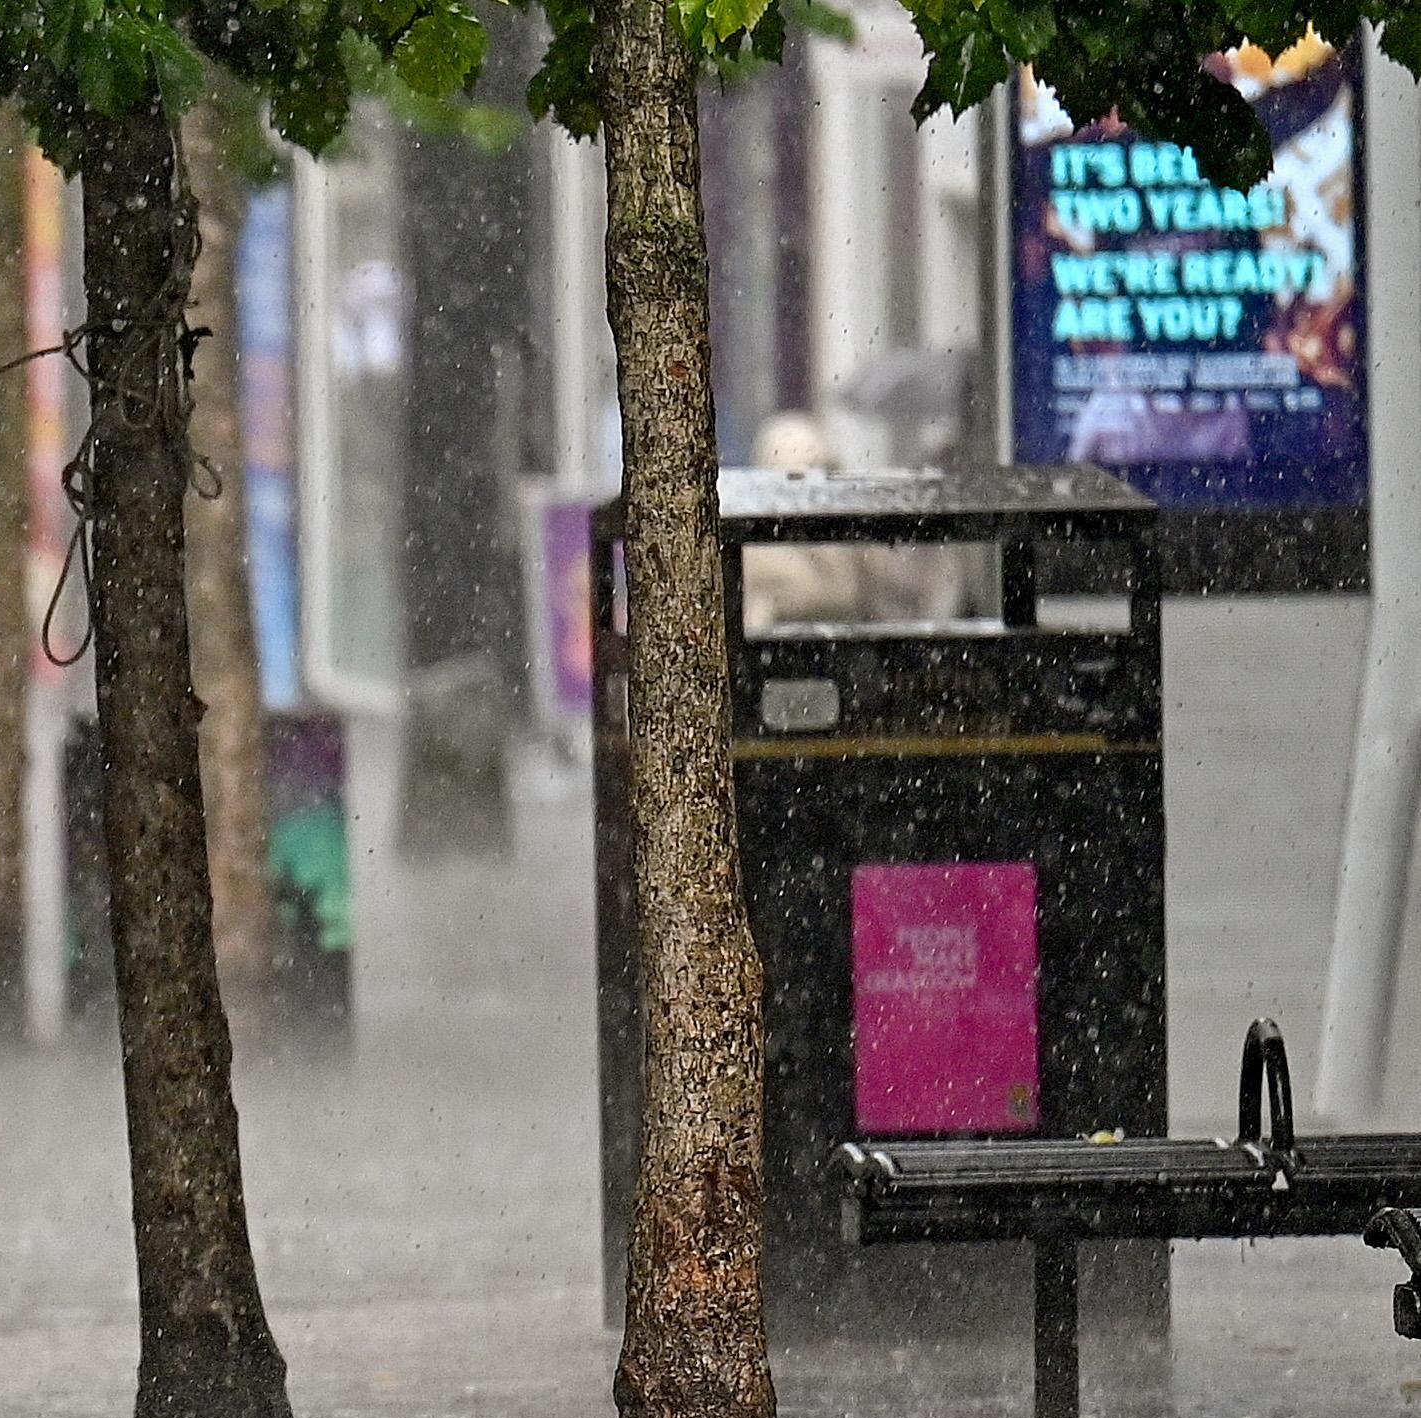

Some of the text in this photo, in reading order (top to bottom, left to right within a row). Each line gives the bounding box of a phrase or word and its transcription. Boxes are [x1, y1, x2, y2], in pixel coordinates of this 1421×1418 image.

[1051, 141, 1206, 188] IT'S BE
[1051, 188, 1141, 232] TWO
[1052, 251, 1177, 294] WE'RE
[1052, 296, 1242, 341] ARE YOU?
